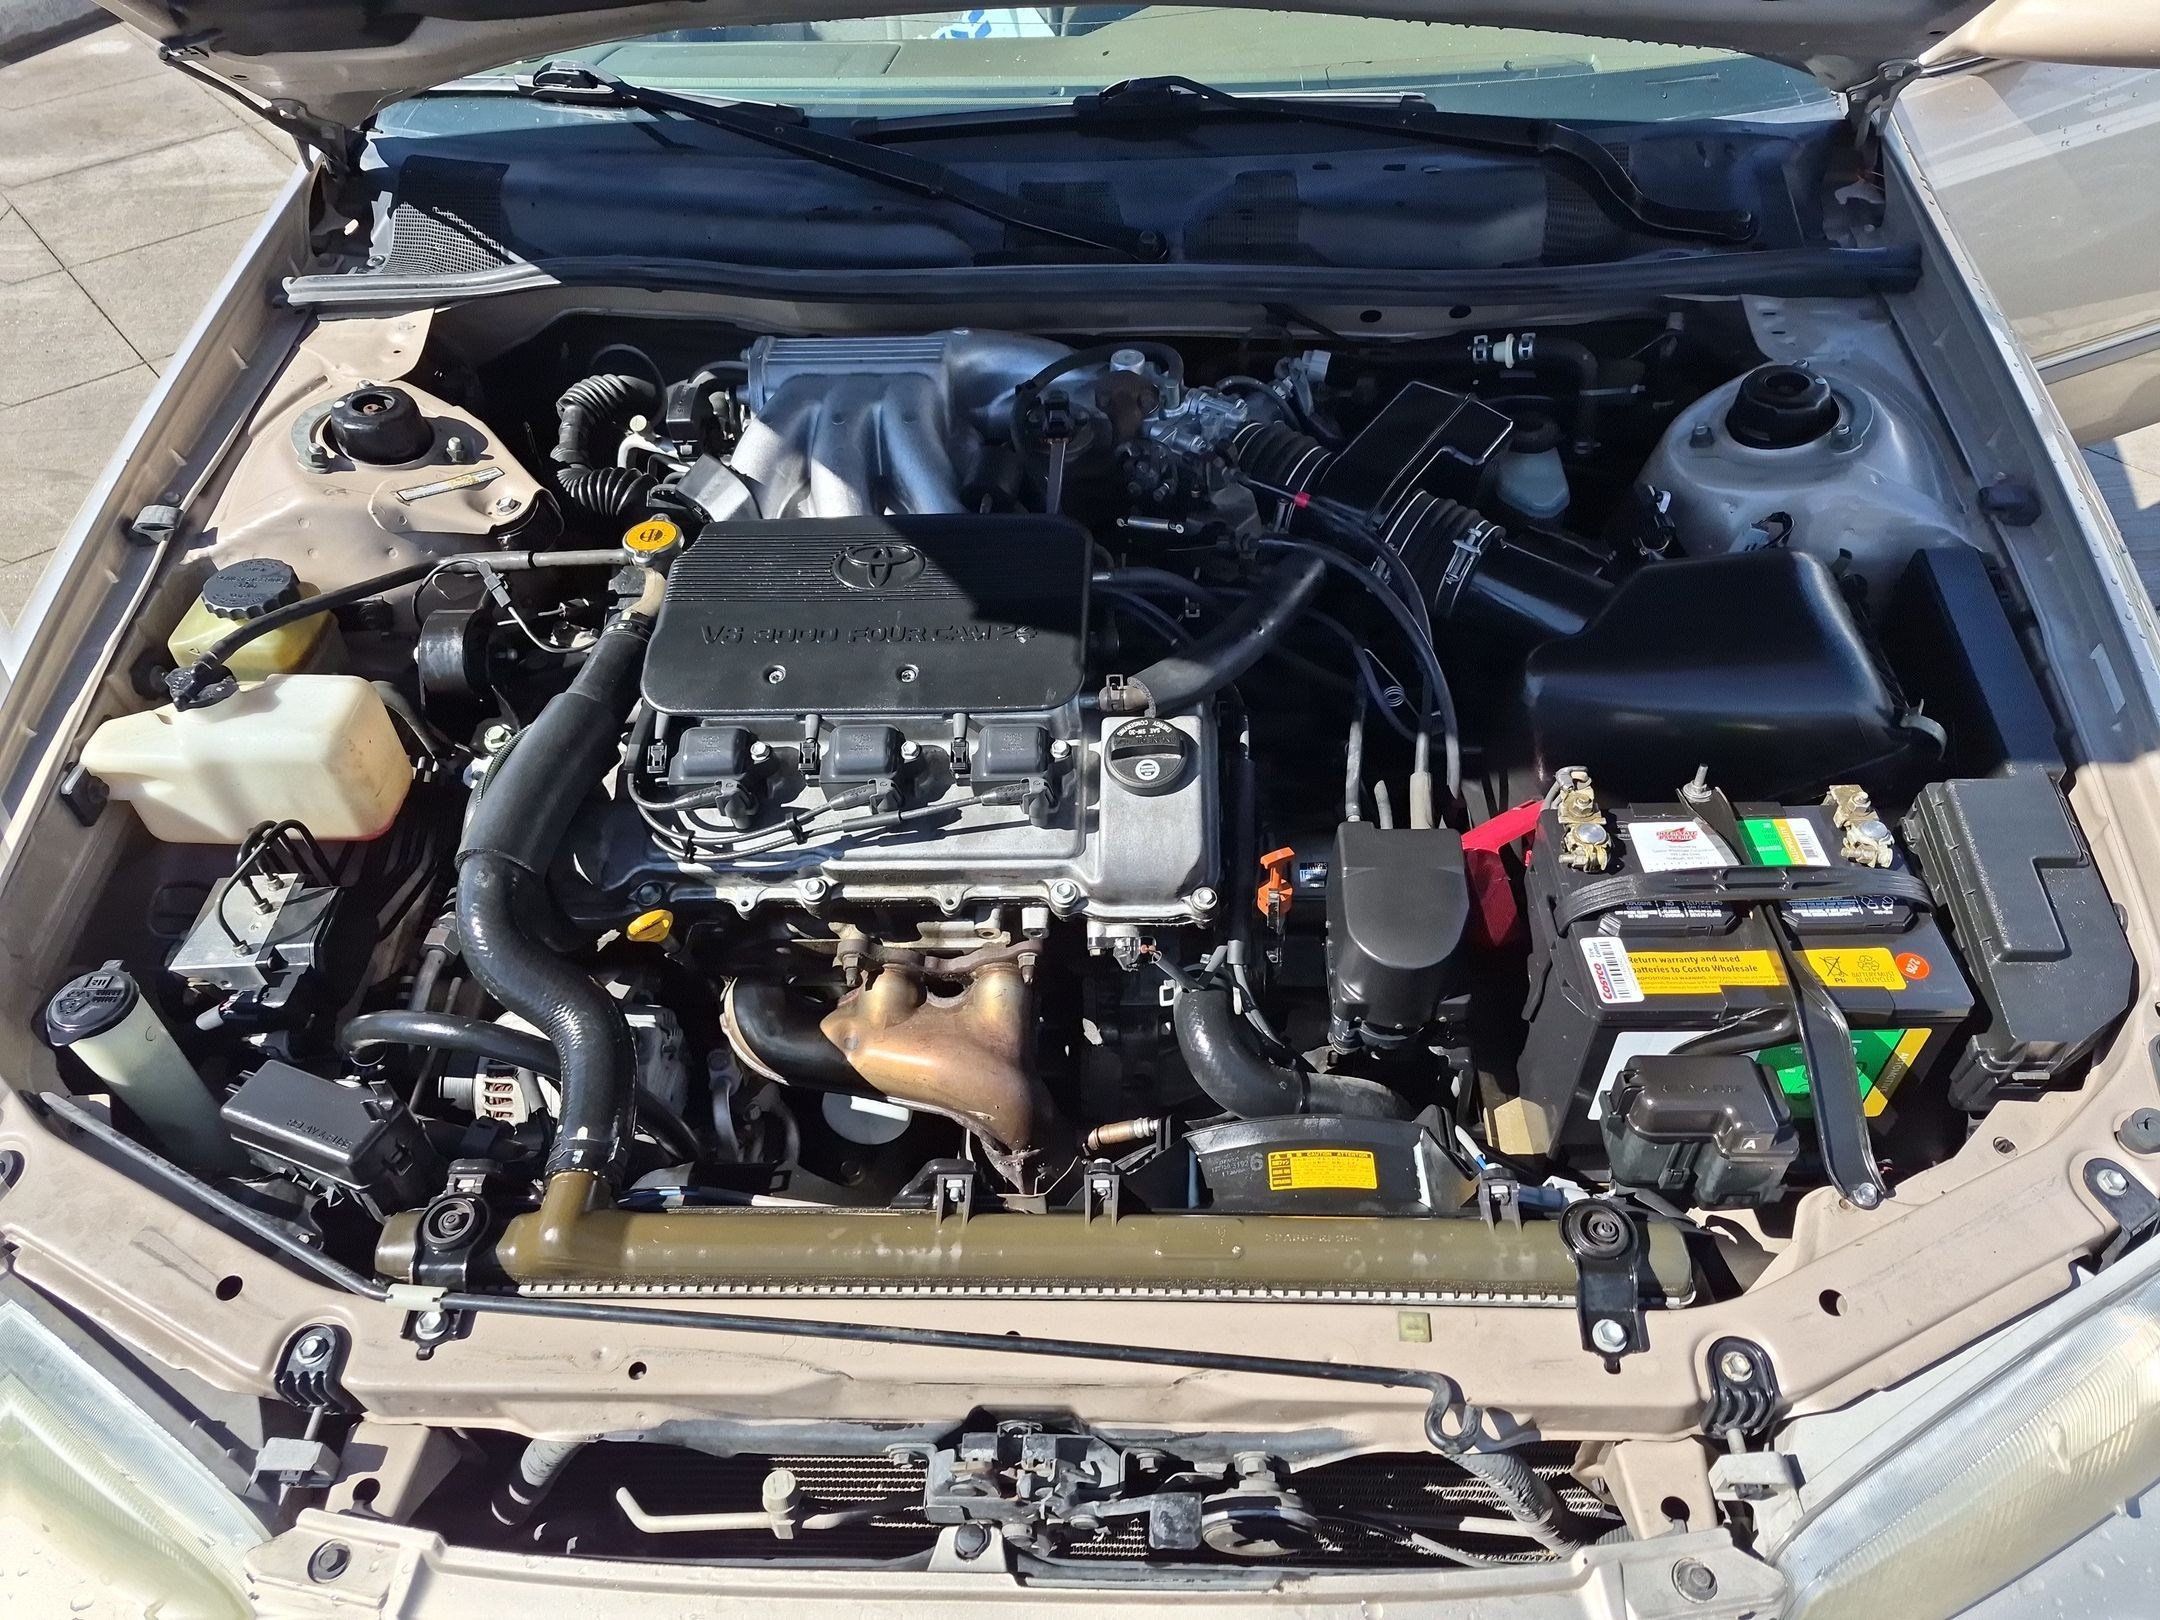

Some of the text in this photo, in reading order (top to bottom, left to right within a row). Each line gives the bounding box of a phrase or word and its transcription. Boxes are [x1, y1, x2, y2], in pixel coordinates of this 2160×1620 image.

[752, 627, 840, 644] 3000
[847, 626, 927, 643] FOUR
[931, 626, 991, 643] CAM
[1659, 956, 1698, 964] warranty
[1682, 965, 1710, 973] Costco
[1711, 964, 1758, 972] Wholesale
[1593, 963, 1612, 1000] COSTCO
[1743, 1140, 1757, 1149] A
